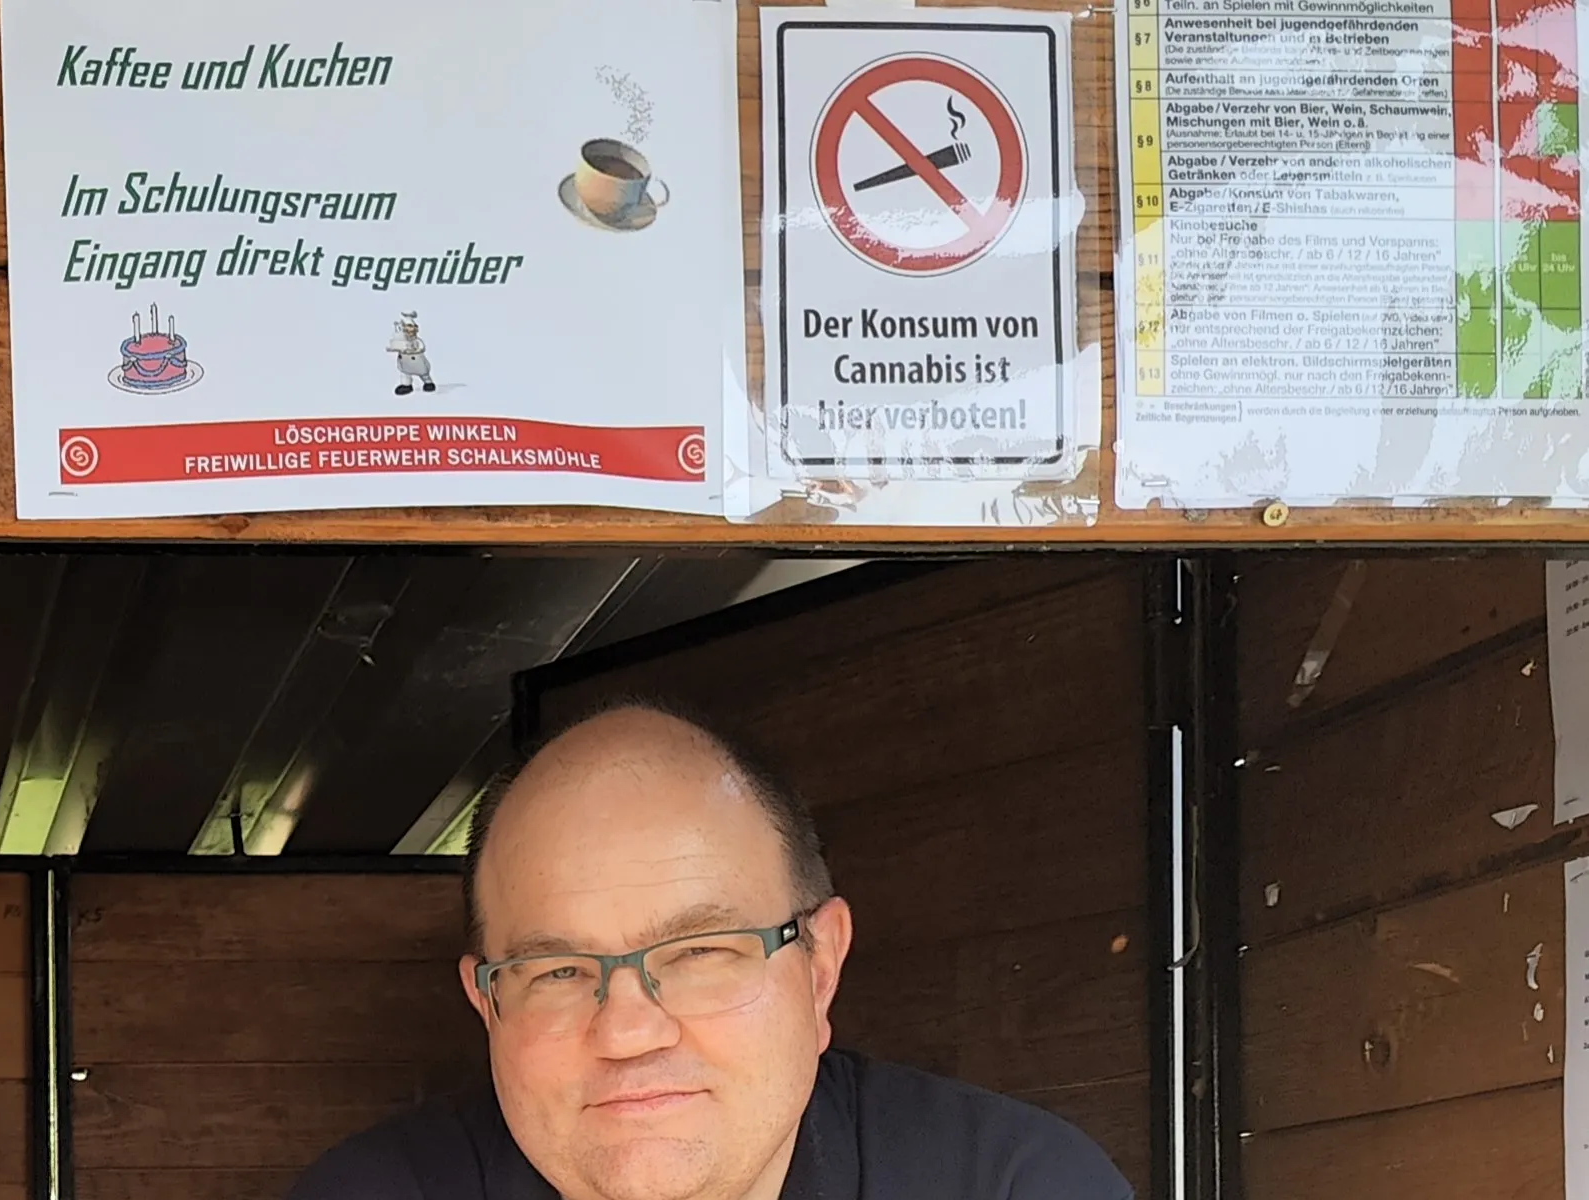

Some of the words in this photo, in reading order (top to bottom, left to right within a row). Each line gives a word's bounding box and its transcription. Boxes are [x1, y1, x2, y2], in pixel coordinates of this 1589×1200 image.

[1203, 2, 1217, 10] an
[1223, 0, 1271, 12] Spielen
[1276, 0, 1294, 11] mit
[1299, 1, 1434, 14] Gewinnmöglichkeiten
[1165, 18, 1252, 29] Anwesenheit
[1257, 18, 1276, 29] bei
[1279, 19, 1419, 33] jugendgefährdenden
[1280, 33, 1304, 43] und
[56, 45, 170, 90] Kaffee
[181, 45, 255, 91] und
[257, 41, 393, 89] Kuchen
[1166, 73, 1235, 85] Aufenthalt
[1240, 76, 1255, 84] an
[1275, 106, 1295, 114] von
[1300, 104, 1328, 116] Bier,
[1332, 104, 1365, 116] Wein,
[1369, 105, 1452, 118] Schaumwein,
[1167, 117, 1246, 131] Mischungen
[1251, 118, 1271, 128] mit
[1275, 118, 1302, 130] Bier,
[1308, 118, 1339, 129] Wein
[1168, 156, 1217, 169] Abgabe
[1229, 156, 1278, 167] Verzehr
[1310, 157, 1360, 168] anderen
[1364, 157, 1451, 169] alkoholischen
[1169, 169, 1236, 181] Getränken
[1240, 170, 1268, 181] oder
[61, 174, 106, 218] Im
[117, 172, 397, 224] Schulungsraum
[1288, 191, 1309, 200] von
[1314, 189, 1399, 202] Tabakwaren,
[1171, 220, 1257, 231] Kinobesuche
[1171, 234, 1192, 244] Nur
[1279, 235, 1301, 246] des
[1305, 235, 1337, 246] Films
[1342, 235, 1365, 246] und
[1370, 236, 1439, 249] Vorspanns:
[1307, 249, 1322, 260] ab
[62, 239, 205, 290] Eingang
[215, 235, 325, 279] direkt
[330, 242, 525, 291] gegenüber
[803, 308, 852, 339] Der
[861, 308, 978, 339] Konsum
[984, 314, 1039, 339] von
[1171, 309, 1220, 323] Abgabe
[1224, 312, 1247, 321] von
[1251, 310, 1293, 321] Filmen
[1313, 310, 1360, 324] Spielen
[1195, 324, 1278, 338] entsprechend
[1283, 324, 1303, 336] der
[1305, 339, 1320, 350] ab
[1171, 355, 1218, 369] Spielen
[1223, 358, 1237, 367] an
[1242, 356, 1298, 368] elektron.
[833, 354, 967, 385] Cannabis
[974, 356, 1011, 385] ist
[1171, 370, 1199, 380] ohne
[1285, 371, 1303, 381] nur
[1308, 370, 1336, 381] nach
[1341, 370, 1362, 382] den
[818, 399, 878, 431] hier
[884, 399, 1027, 430] verboten!
[273, 424, 420, 446] LÖSCHGRUPPE
[426, 423, 517, 442] WINKELN
[184, 451, 313, 474] FREIWILLIGE
[318, 447, 441, 467] FEUERWEHR
[447, 447, 602, 470] SCHALKSMÜHLE
